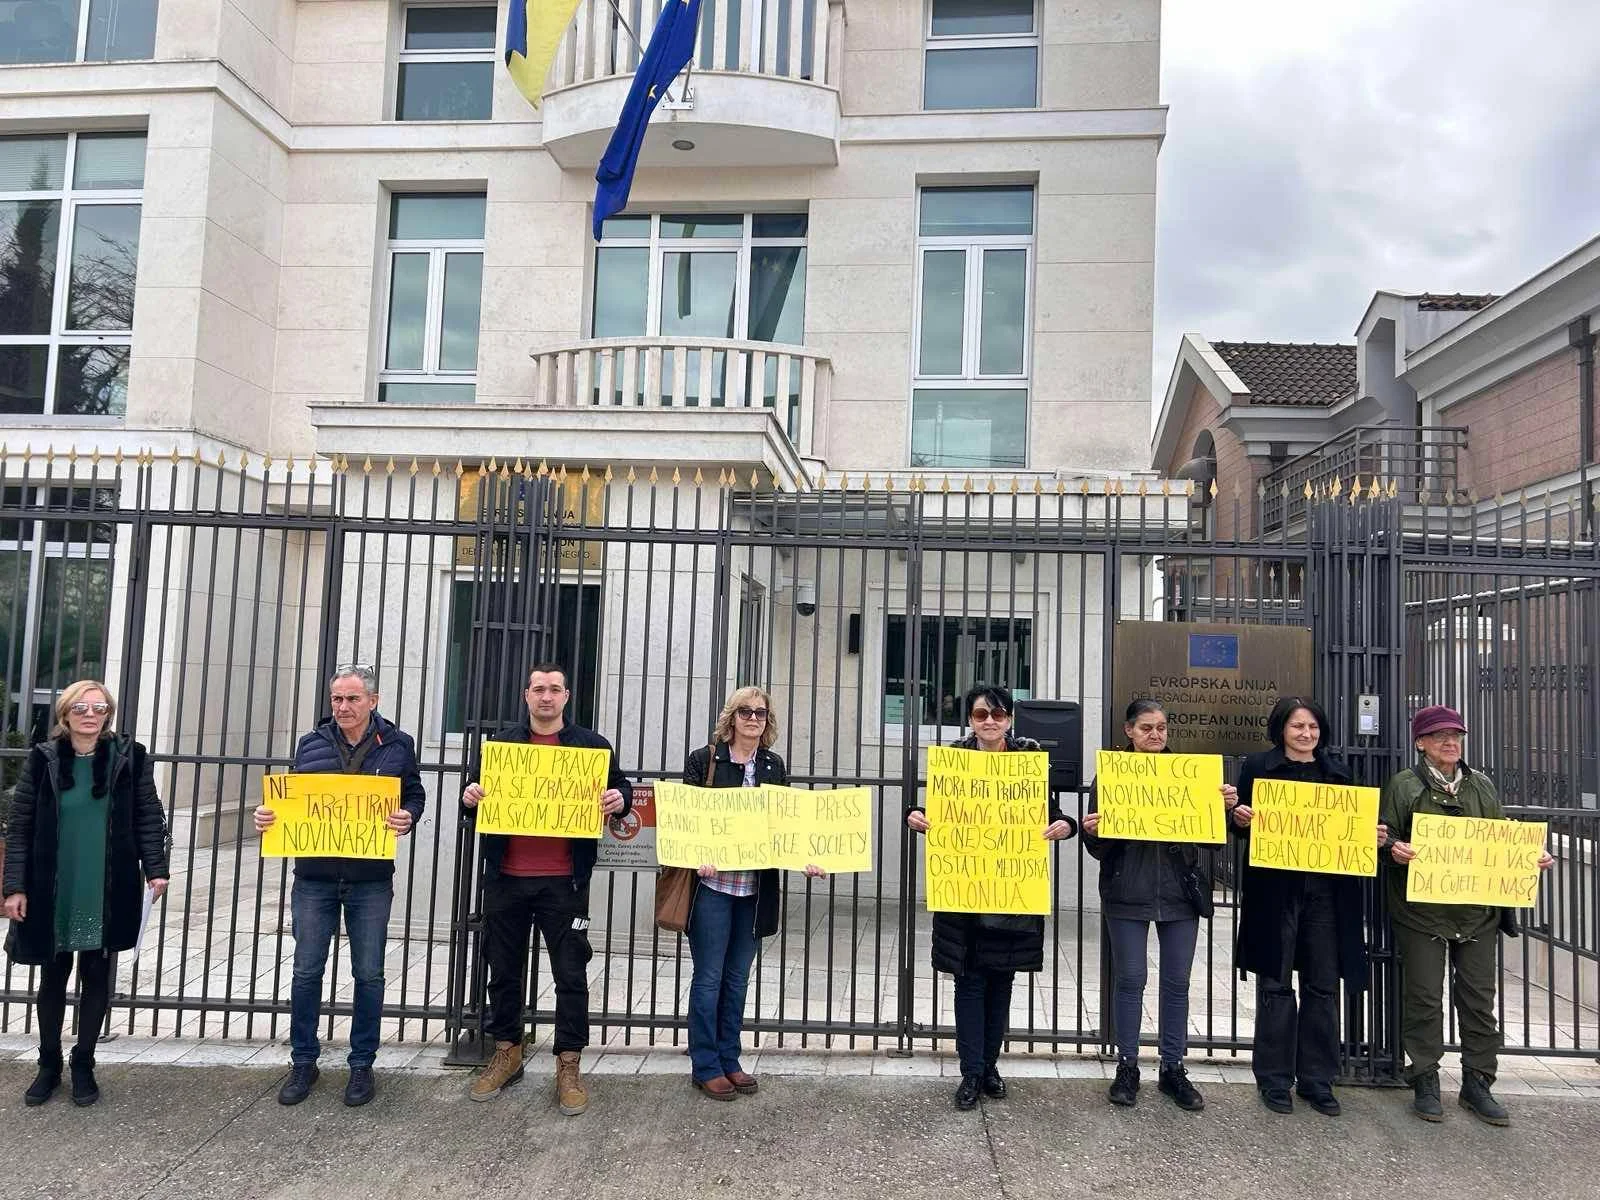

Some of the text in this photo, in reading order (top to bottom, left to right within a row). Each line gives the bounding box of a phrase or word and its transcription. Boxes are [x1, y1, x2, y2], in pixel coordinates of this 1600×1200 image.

[1150, 676, 1277, 691] EVROPSKA UNIJA
[1209, 695, 1218, 704] U
[1220, 694, 1262, 706] CRNOJ
[1168, 713, 1268, 727] ROPEAN UNIO
[1201, 729, 1215, 740] TO
[485, 746, 606, 778] IMAMO PRAVO
[930, 749, 1042, 776] JAVNI INTERES
[1171, 755, 1198, 779] CG
[269, 775, 297, 800] NE
[483, 775, 503, 799] DA
[508, 777, 527, 798] SE
[932, 774, 966, 799] MORA
[1102, 783, 1199, 810] NOVINARA
[1257, 781, 1297, 808] ONAJ
[481, 803, 501, 829] NA
[507, 802, 549, 830] SVOM
[768, 789, 862, 822] FREE PRESS
[659, 810, 737, 836] CANNOT BE
[1337, 815, 1364, 842] JE
[283, 821, 390, 856] NOVINARA!
[808, 831, 867, 857] SOCIETY
[928, 825, 947, 849] CG
[983, 827, 1039, 854] SMIJE
[930, 854, 1050, 882] OSTATI MEDIJSKA
[1250, 837, 1375, 874] JEDAN OD NAS
[1414, 844, 1473, 865] ZANIMA
[1507, 849, 1537, 870] VAS
[932, 879, 1029, 910] KOLONIJA
[1413, 870, 1433, 894] DA
